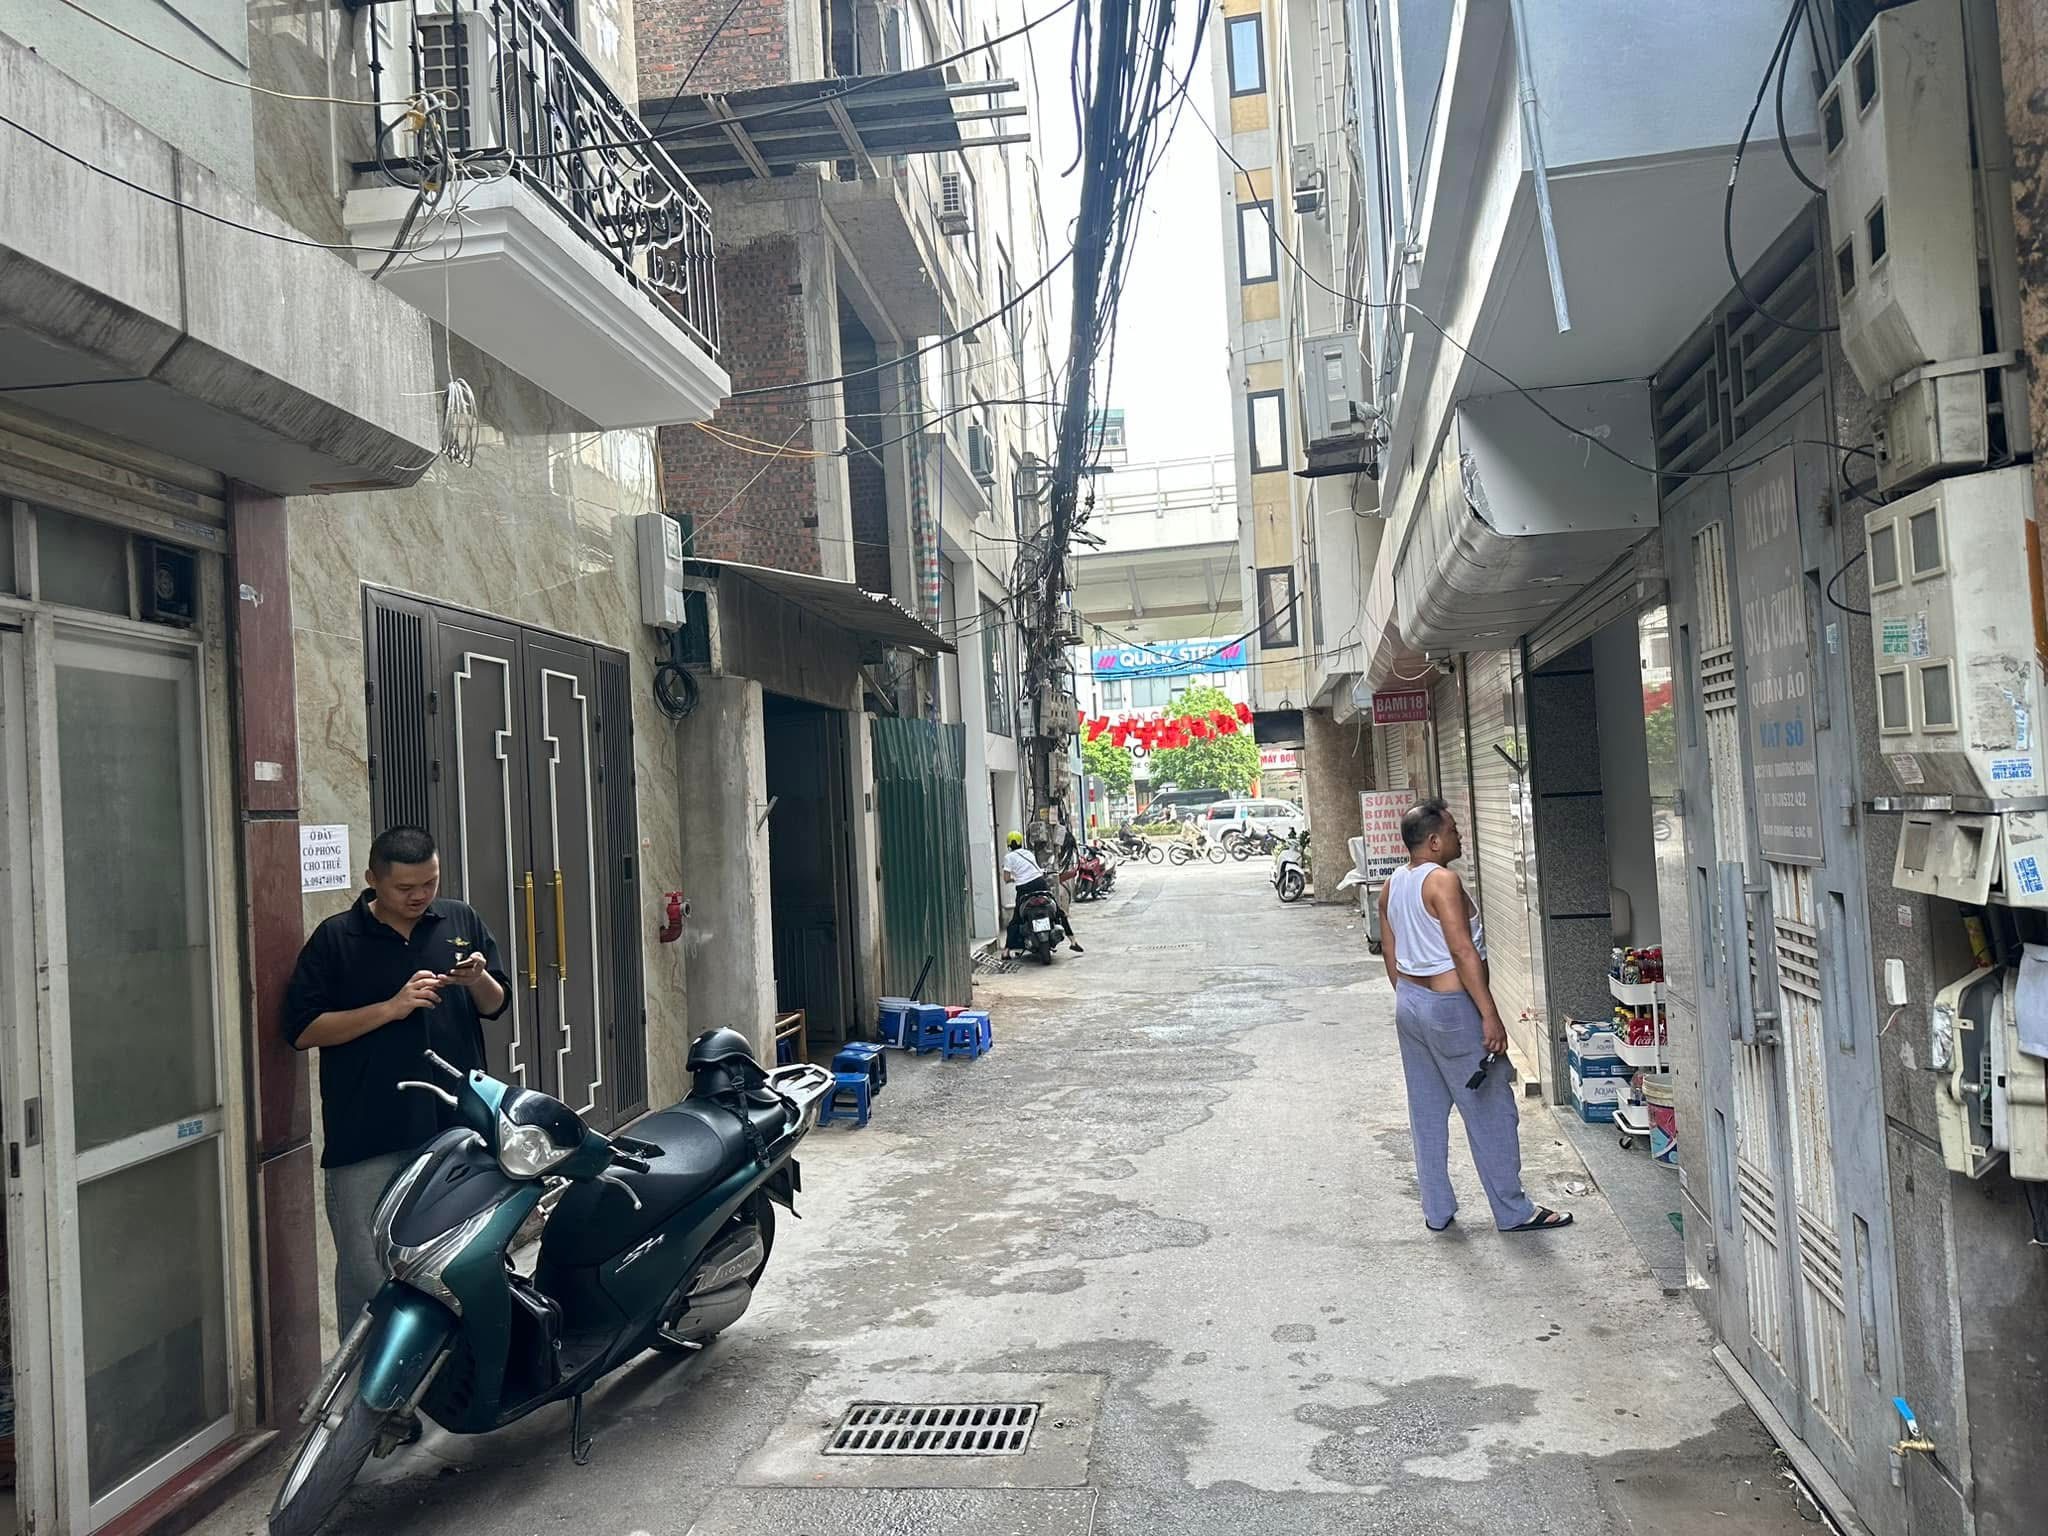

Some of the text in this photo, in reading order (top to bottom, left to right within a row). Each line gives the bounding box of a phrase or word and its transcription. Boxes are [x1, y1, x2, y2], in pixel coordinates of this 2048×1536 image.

[1119, 645, 1218, 667] QUICK STEP
[1787, 666, 1805, 699] ÁO
[303, 861, 321, 871] CHO
